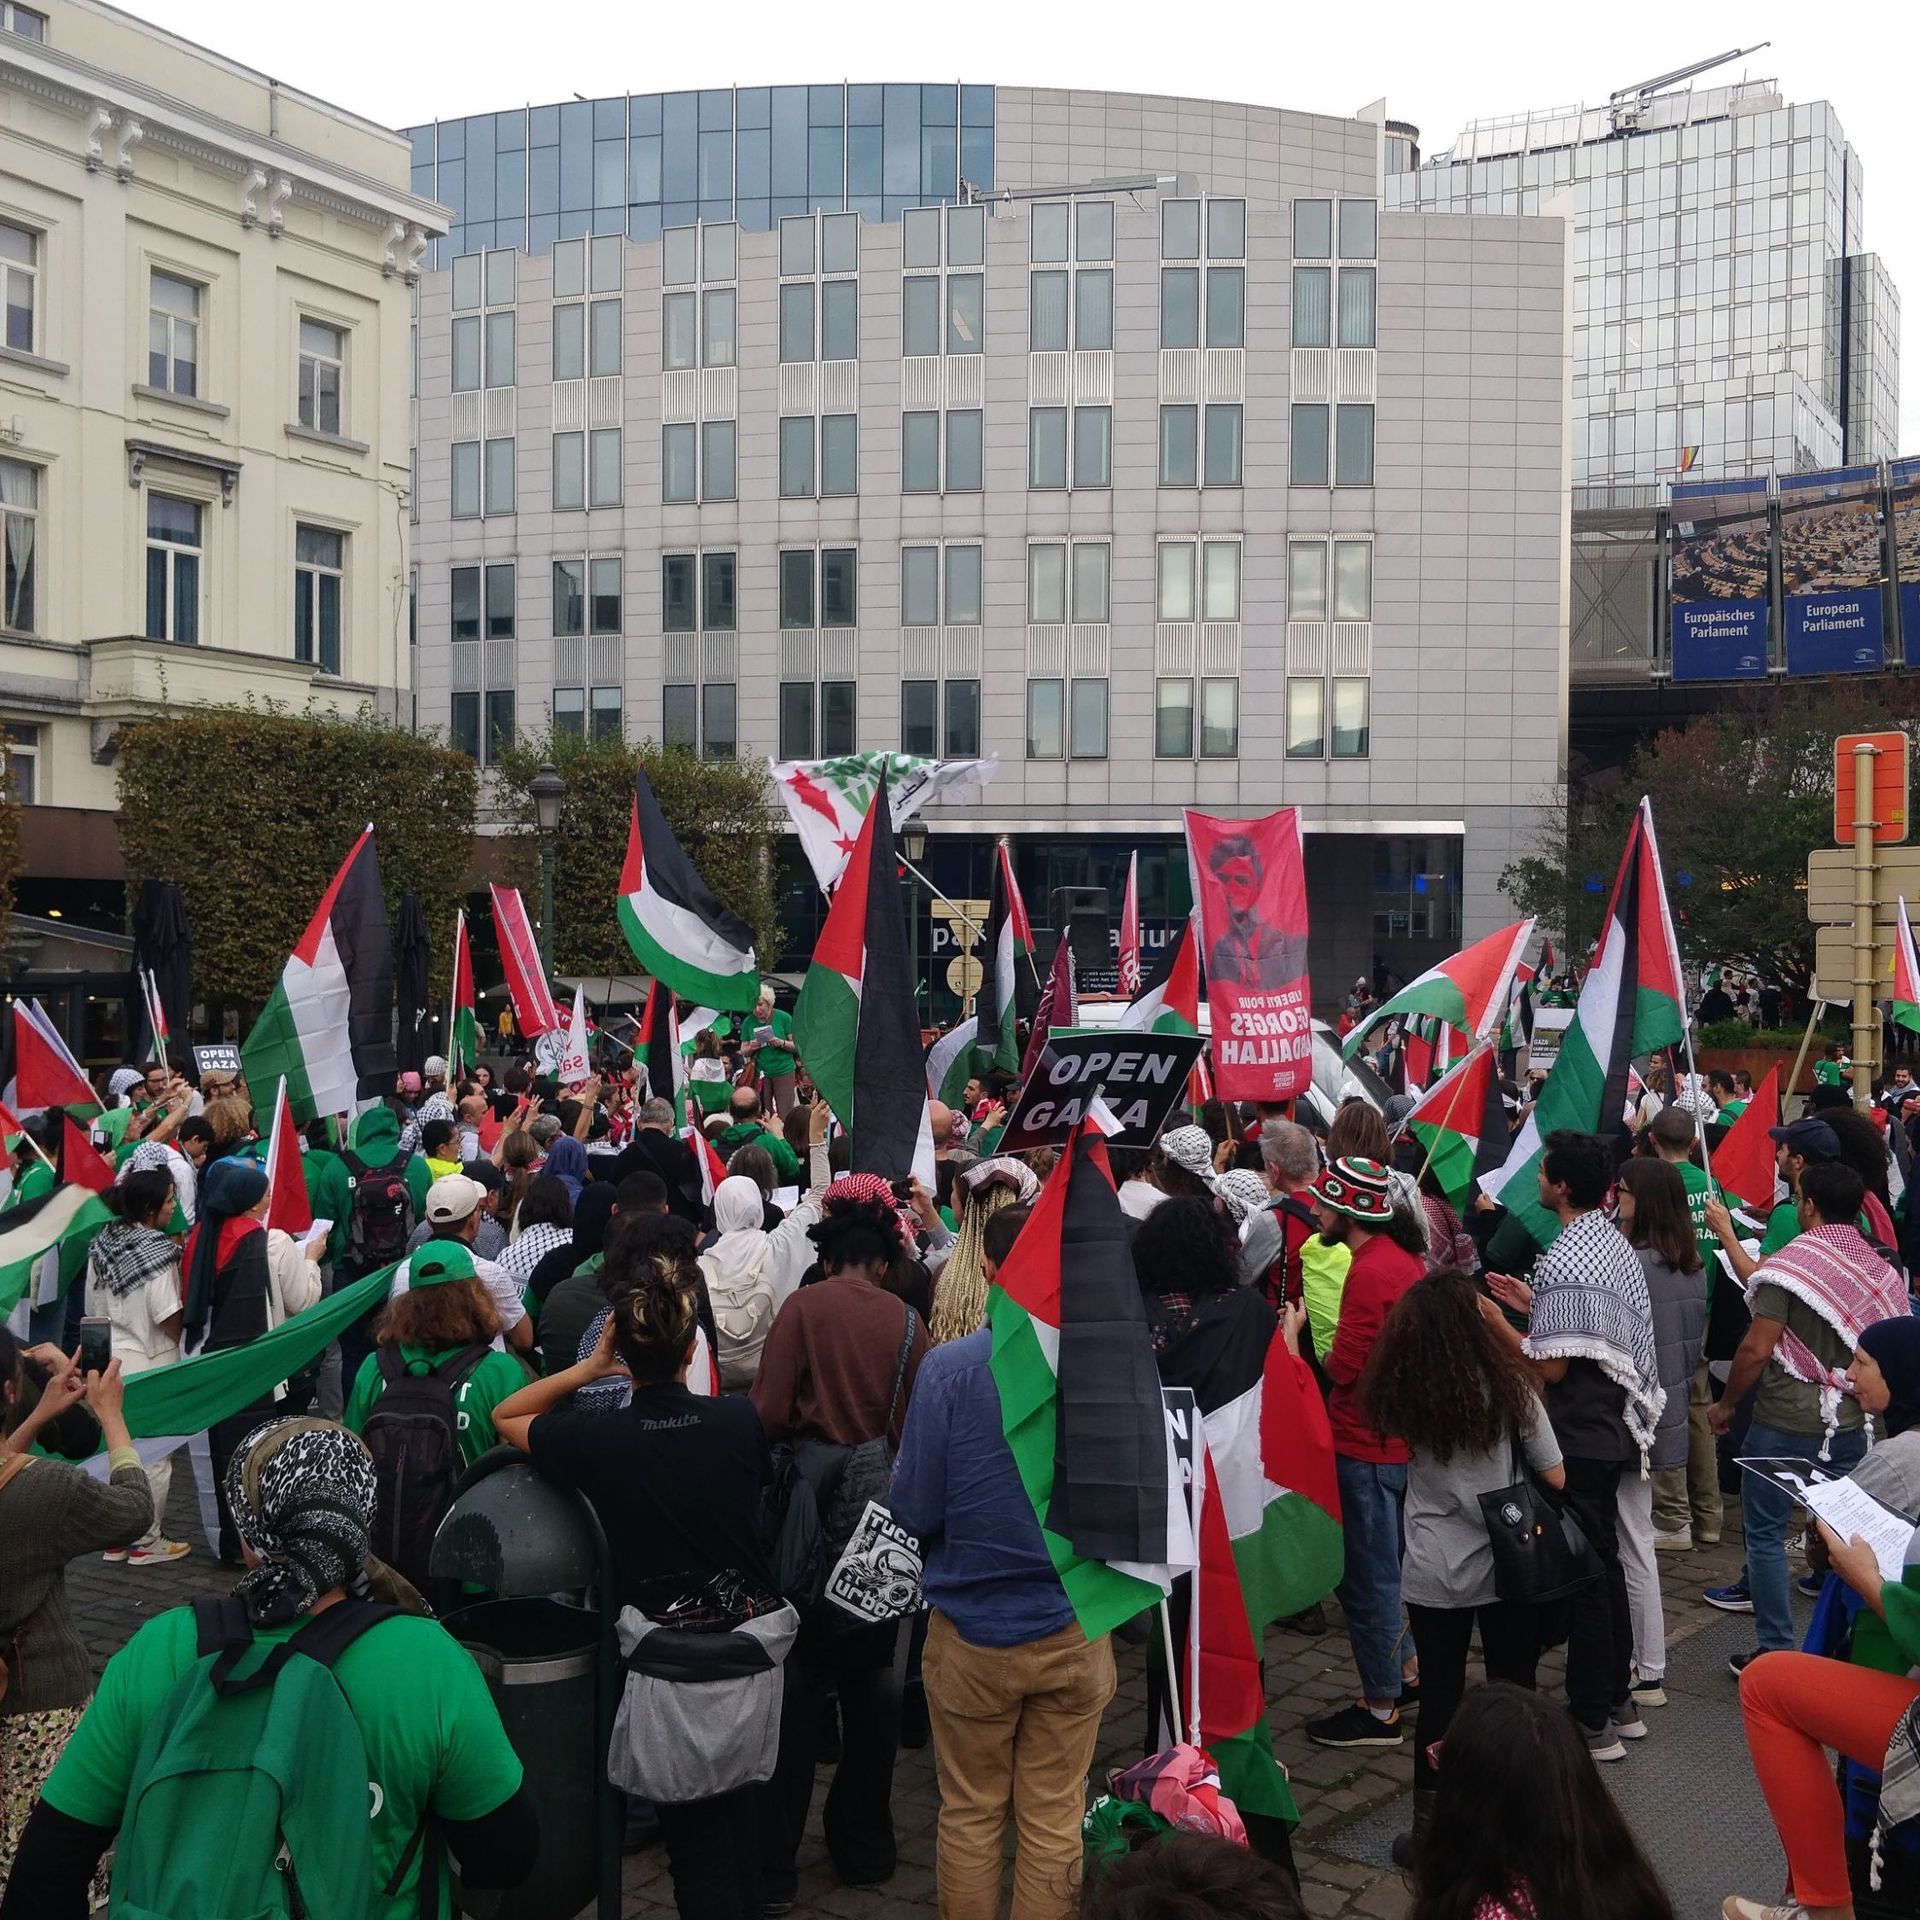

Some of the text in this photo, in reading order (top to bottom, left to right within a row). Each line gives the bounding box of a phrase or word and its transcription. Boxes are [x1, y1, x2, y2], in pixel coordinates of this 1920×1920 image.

[1806, 603, 1859, 618] European
[1684, 611, 1755, 626] Europäisches
[1803, 616, 1865, 633] Parliament
[1690, 624, 1749, 638] Parlament
[200, 1049, 235, 1059] OPEN
[202, 1060, 239, 1070] GAZA
[1049, 1052, 1176, 1086] OPEN
